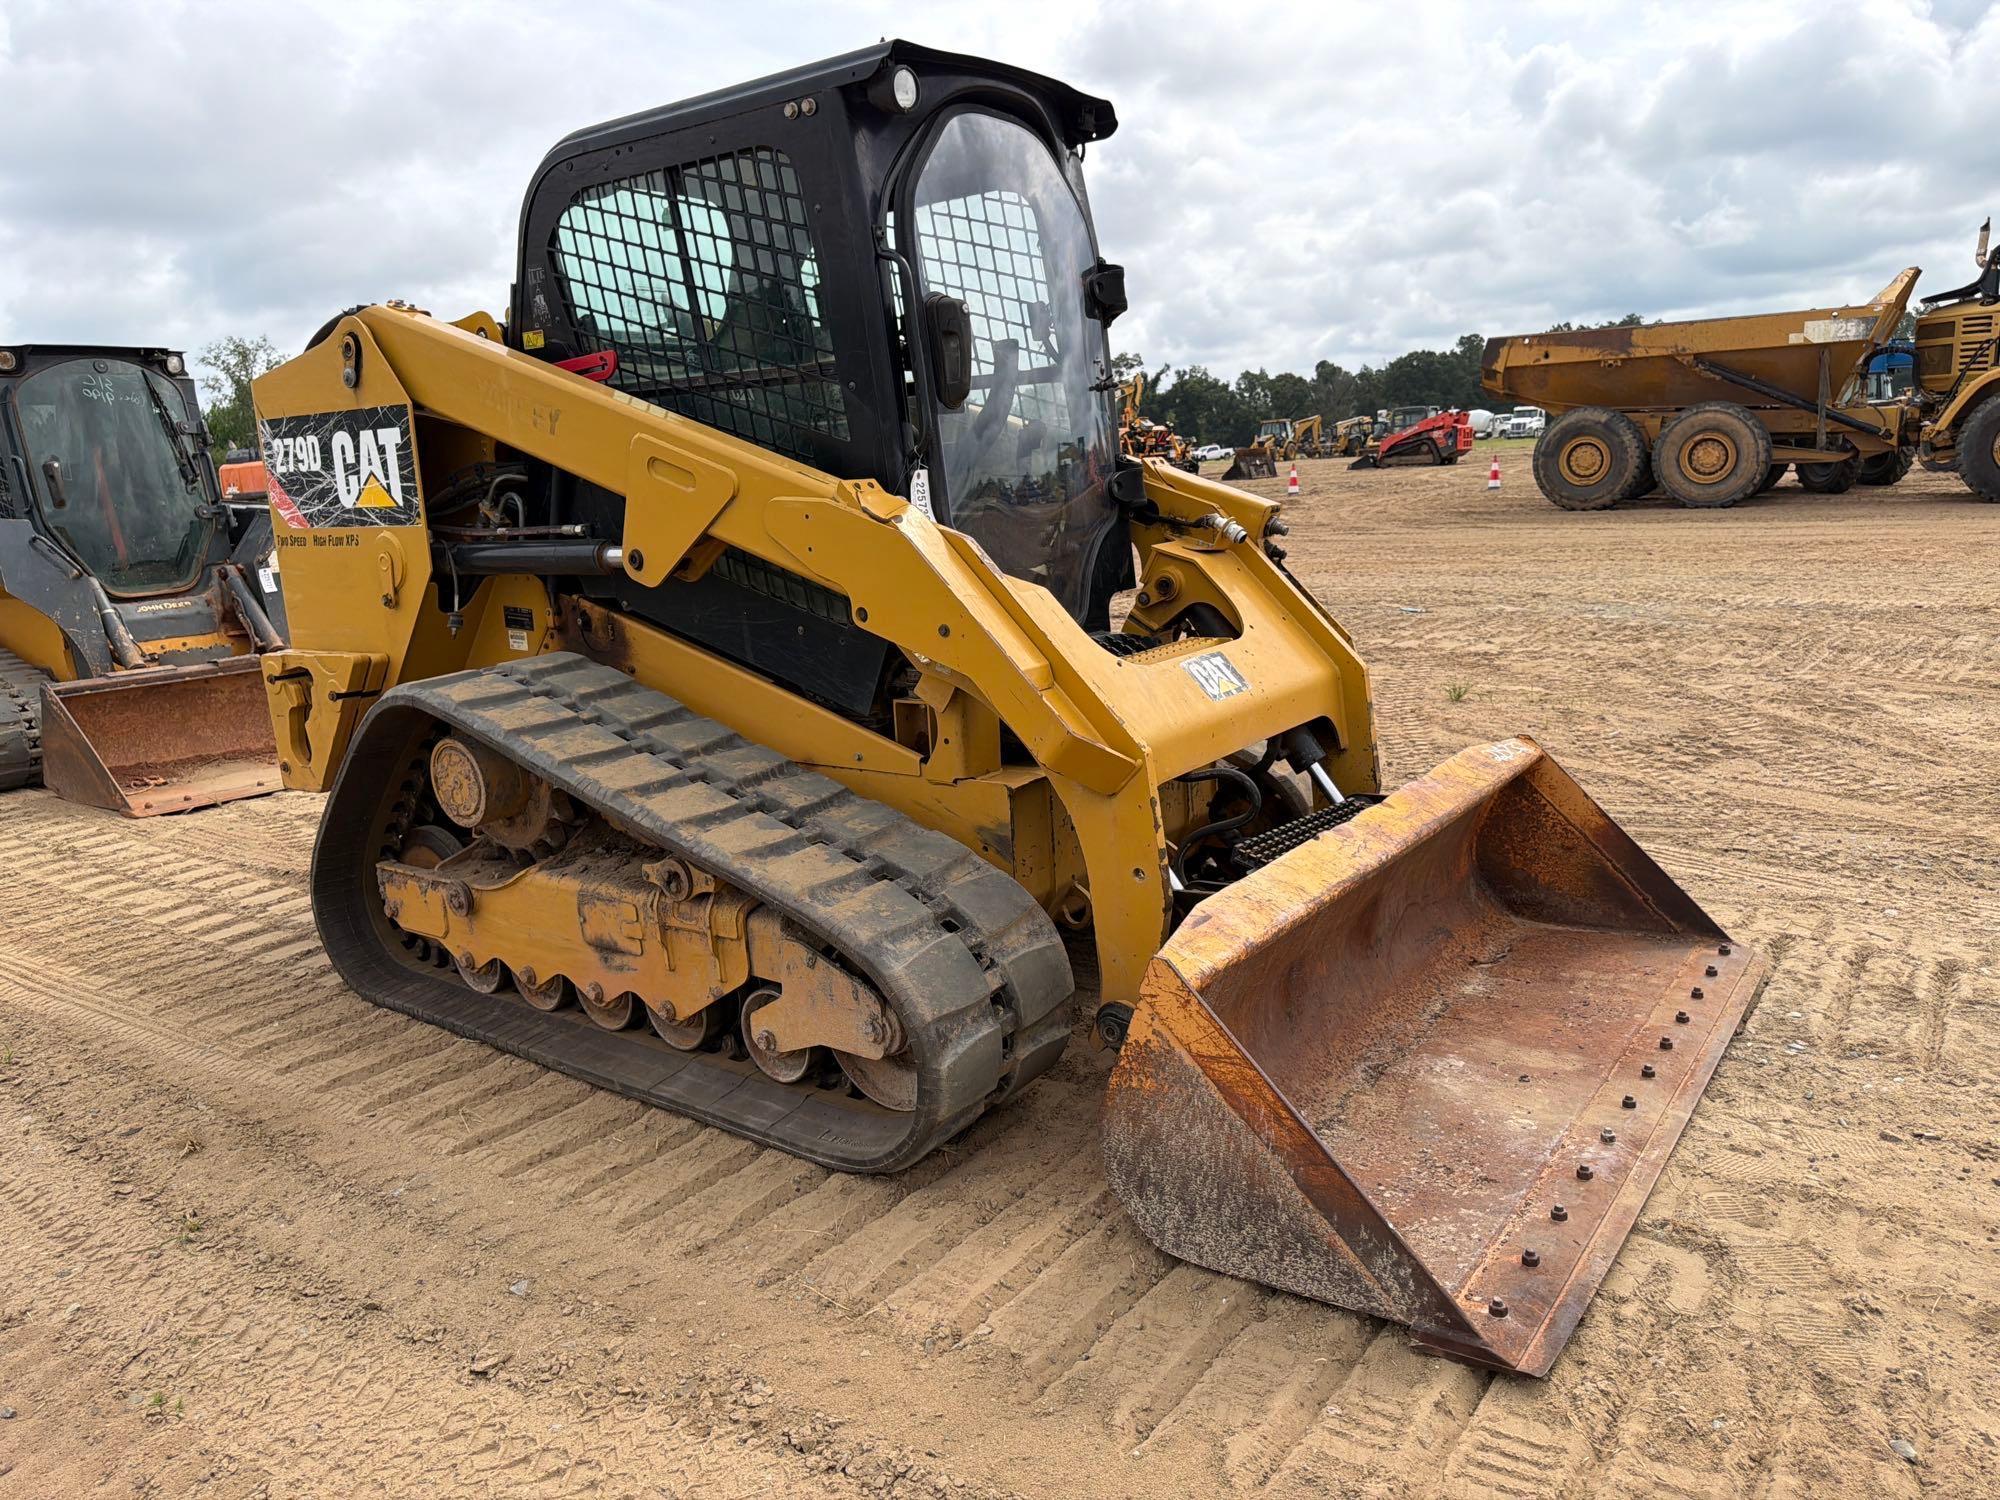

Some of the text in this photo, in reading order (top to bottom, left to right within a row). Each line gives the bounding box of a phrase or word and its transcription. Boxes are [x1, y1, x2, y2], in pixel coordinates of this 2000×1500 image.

[272, 434, 322, 473] 279D
[331, 427, 404, 509] CAT
[289, 534, 307, 546] SPEED
[327, 534, 345, 547] FLOW
[345, 534, 359, 546] XPS
[136, 604, 163, 613] JOHN
[1187, 656, 1243, 696] CAT
